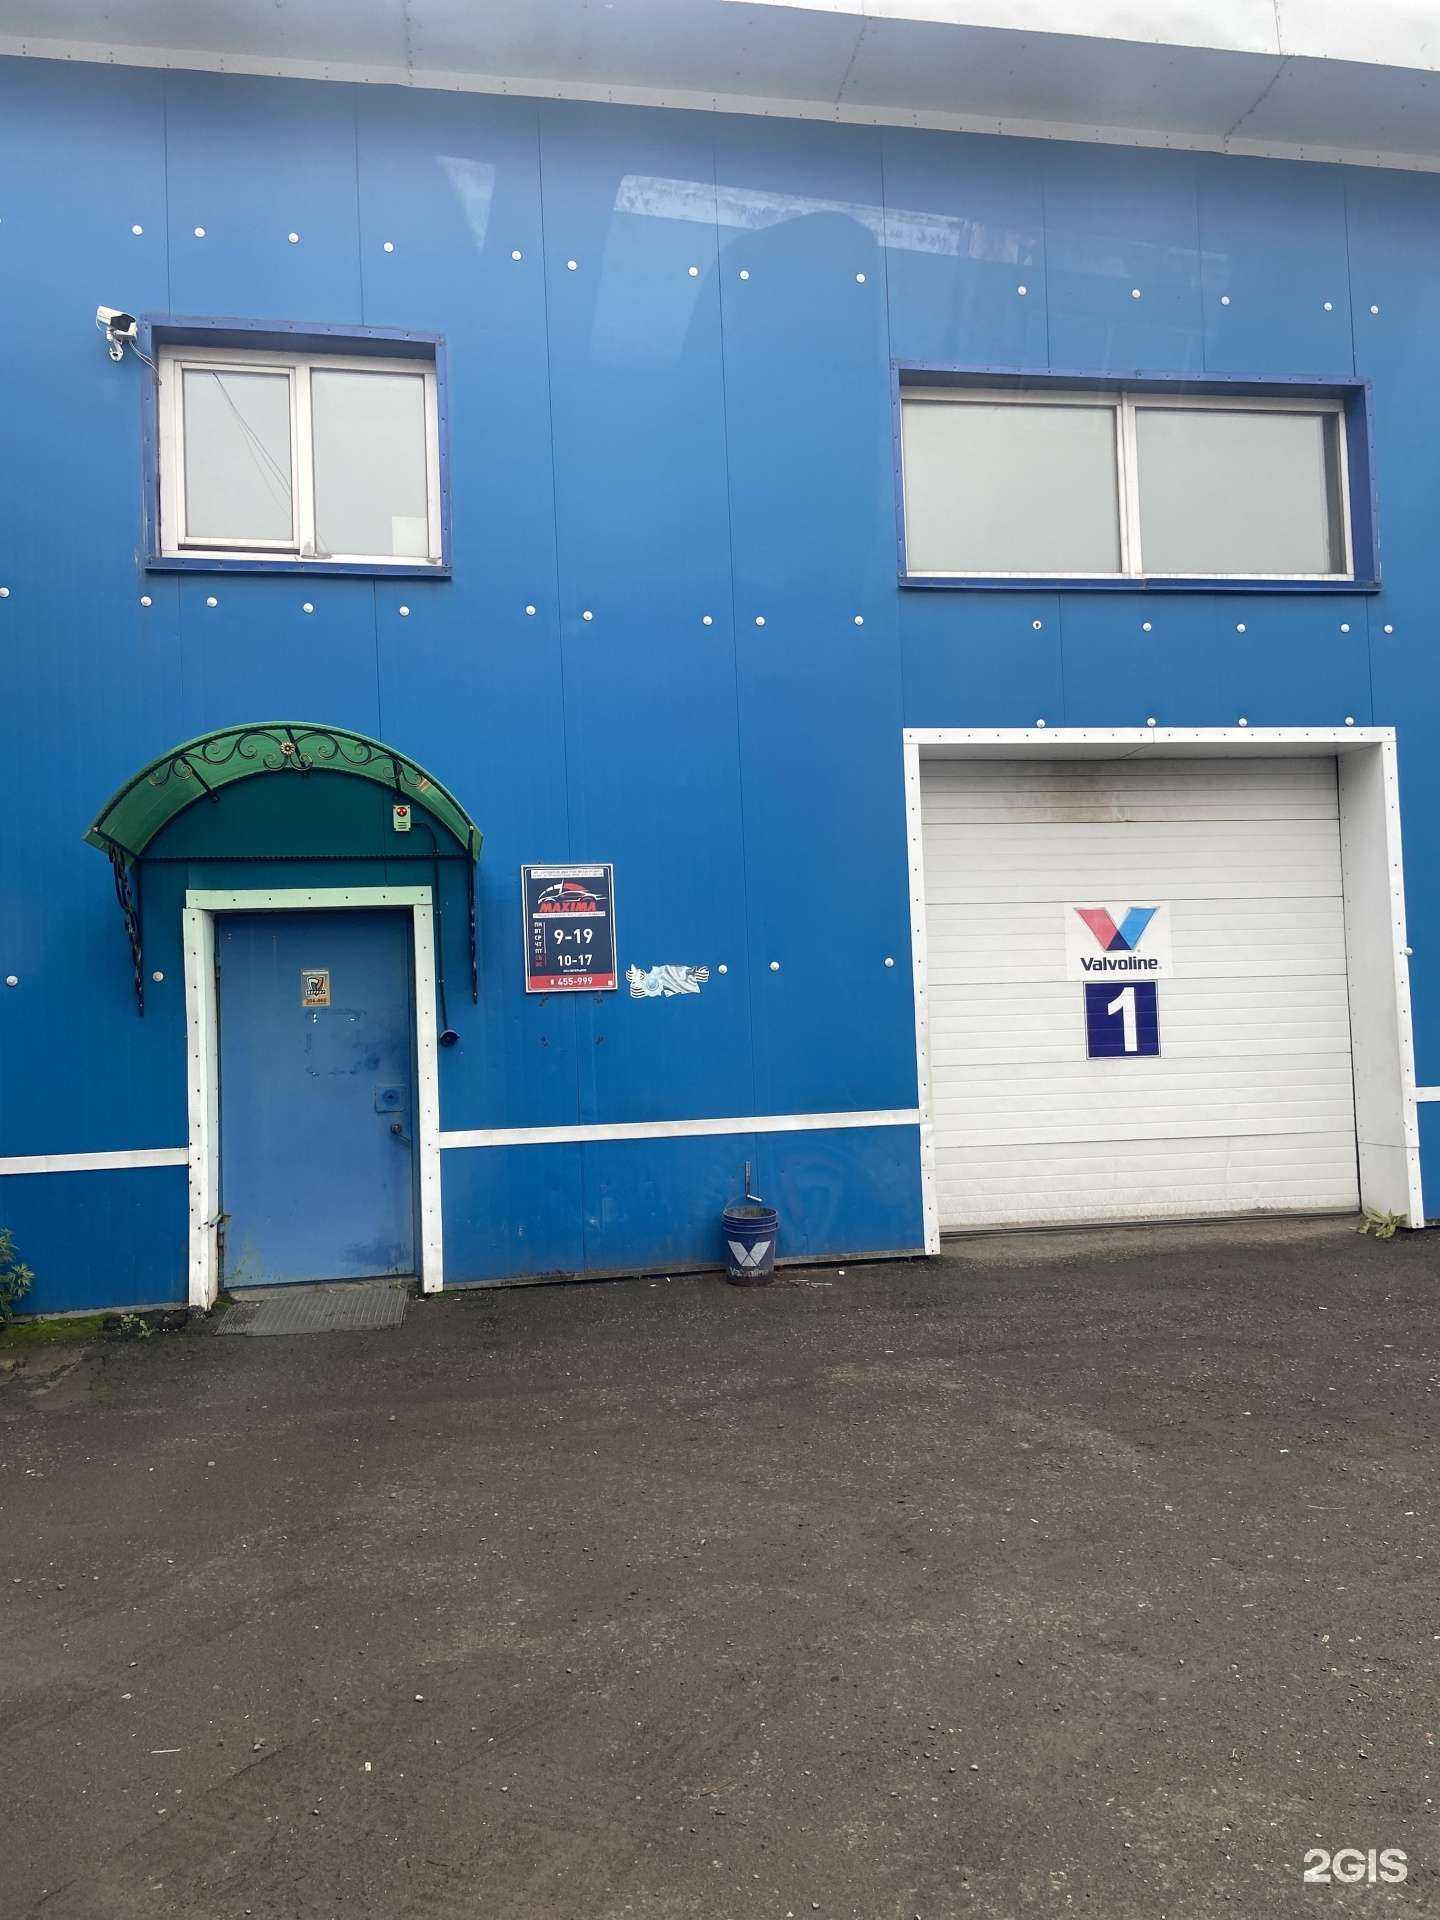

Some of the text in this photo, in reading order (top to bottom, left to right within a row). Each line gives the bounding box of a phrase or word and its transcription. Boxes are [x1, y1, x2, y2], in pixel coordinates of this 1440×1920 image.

[540, 901, 597, 913] MAXIMA
[554, 928, 593, 945] 9-19
[557, 954, 592, 967] 10-17
[1080, 956, 1158, 971] Valvoline
[557, 977, 593, 986] 455-999
[1107, 986, 1138, 1052] 1
